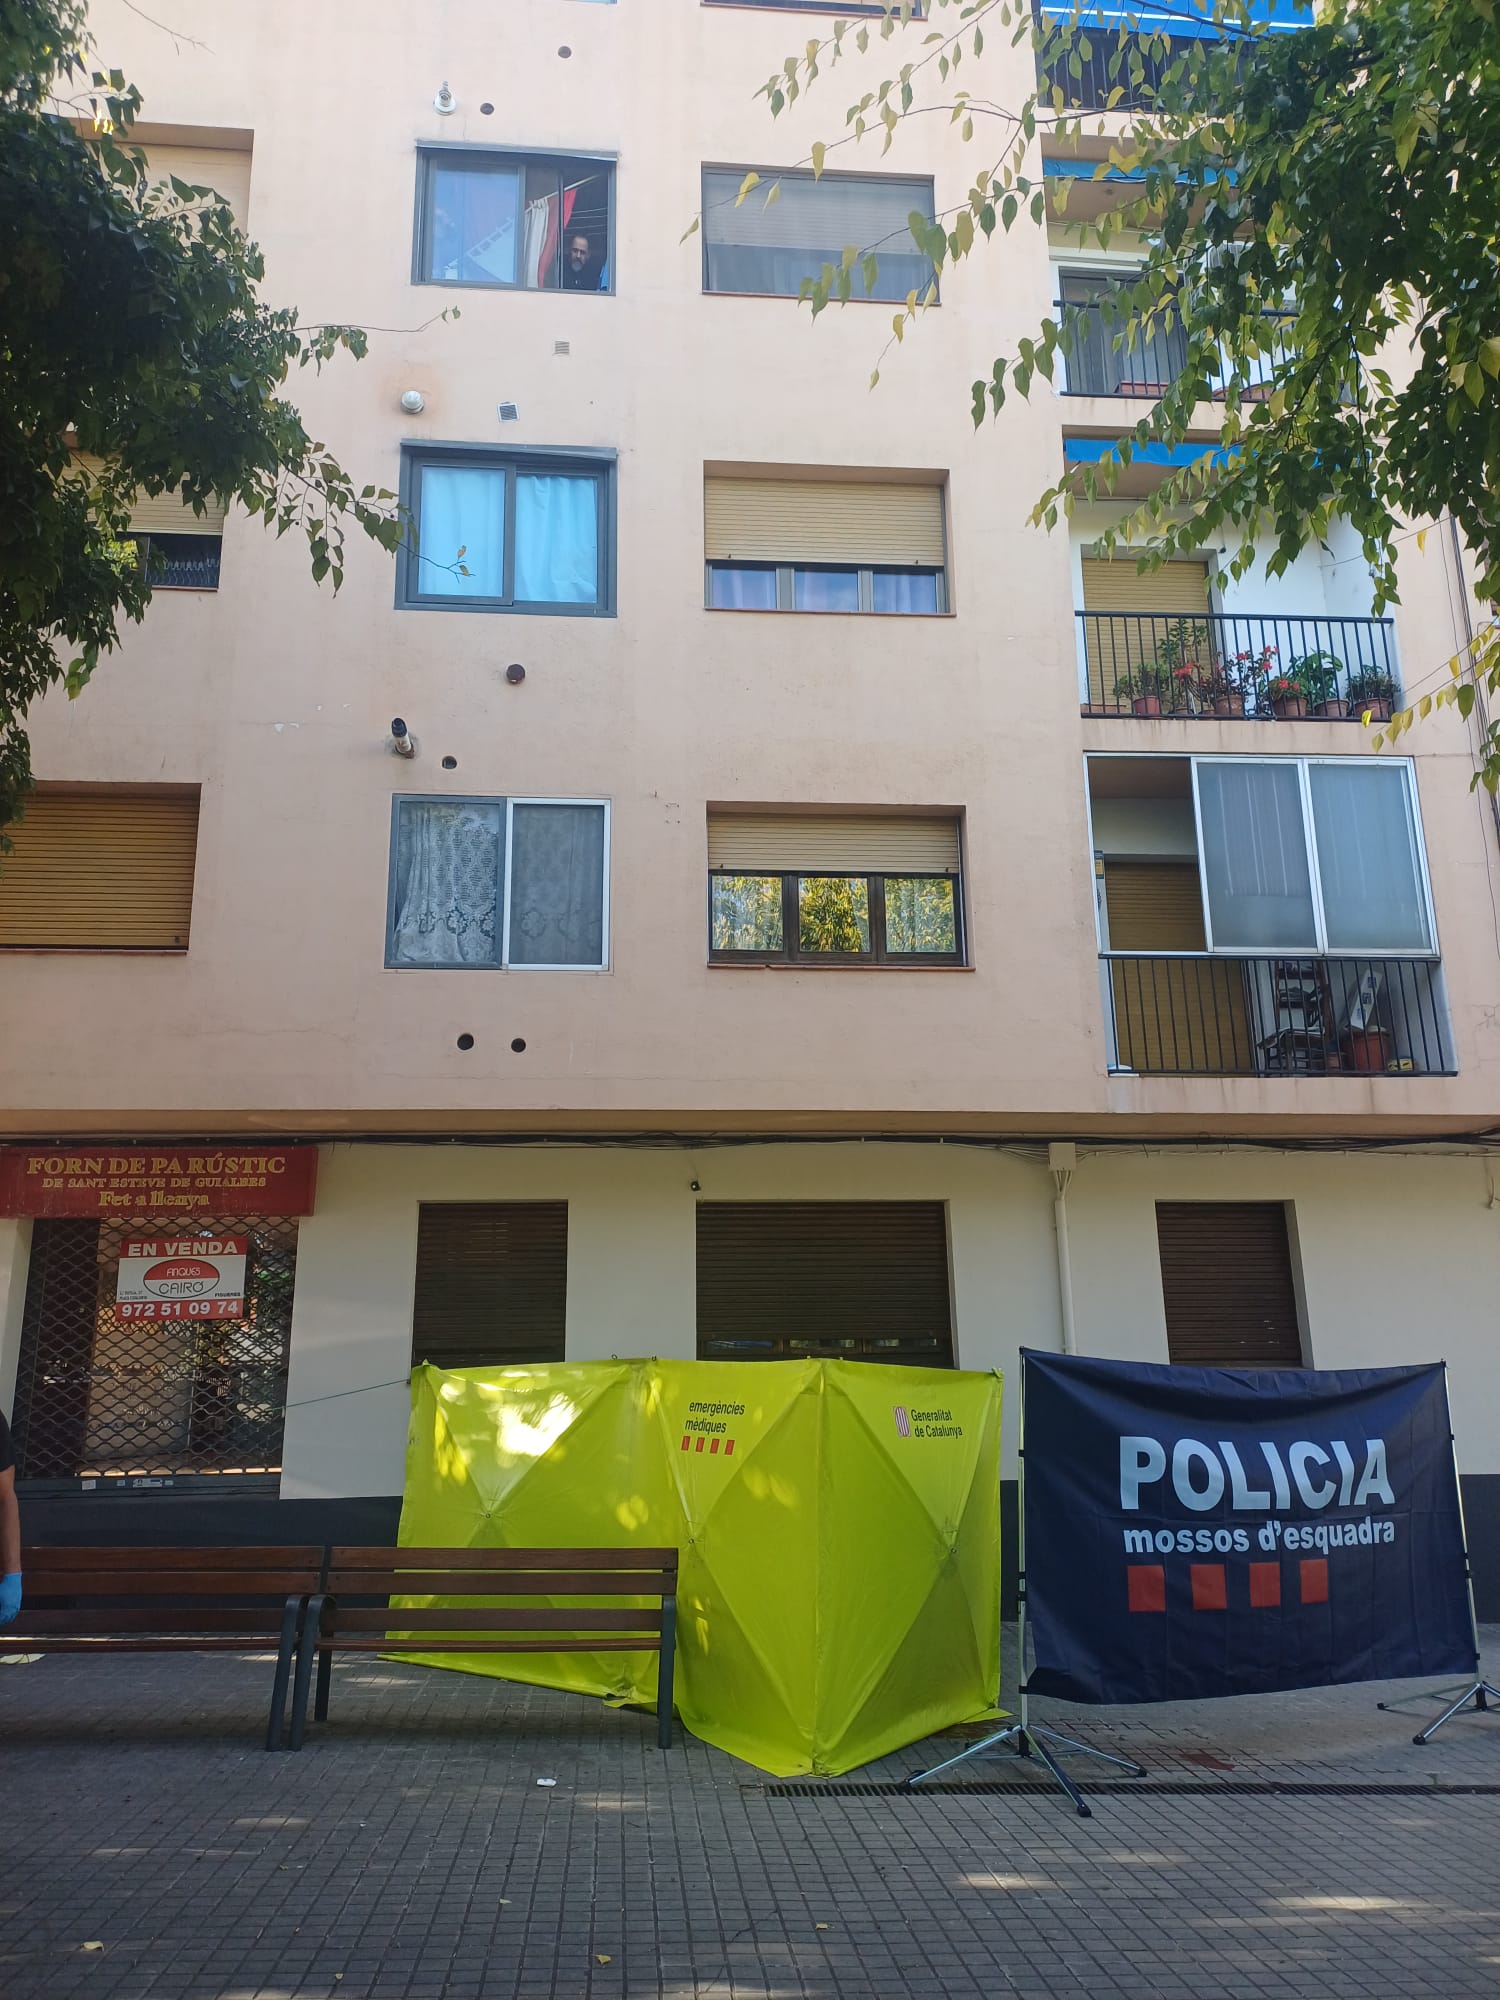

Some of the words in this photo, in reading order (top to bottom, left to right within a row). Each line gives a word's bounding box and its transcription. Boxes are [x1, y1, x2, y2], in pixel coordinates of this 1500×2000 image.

[26, 1157, 104, 1174] FORN
[107, 1157, 145, 1174] DE
[150, 1157, 184, 1174] PA
[187, 1152, 286, 1174] RÚSTIC
[42, 1178, 63, 1187] DE
[67, 1178, 106, 1187] SANT
[109, 1177, 165, 1187] ESTEVE
[171, 1177, 190, 1187] DE
[98, 1191, 131, 1206] Fet
[135, 1195, 147, 1206] a
[149, 1190, 209, 1209] llenya
[128, 1243, 157, 1257] EN
[164, 1241, 238, 1255] VENDA
[121, 1303, 156, 1317] 972
[160, 1302, 181, 1316] 51
[188, 1301, 211, 1315] 09
[217, 1301, 238, 1314] 74
[911, 1408, 953, 1422] Generalitat
[914, 1425, 924, 1438] de
[925, 1424, 963, 1439] Catalunya
[1119, 1436, 1395, 1511] POLICIA
[1123, 1528, 1250, 1553] mossos
[1257, 1516, 1395, 1555] d'esquadra
